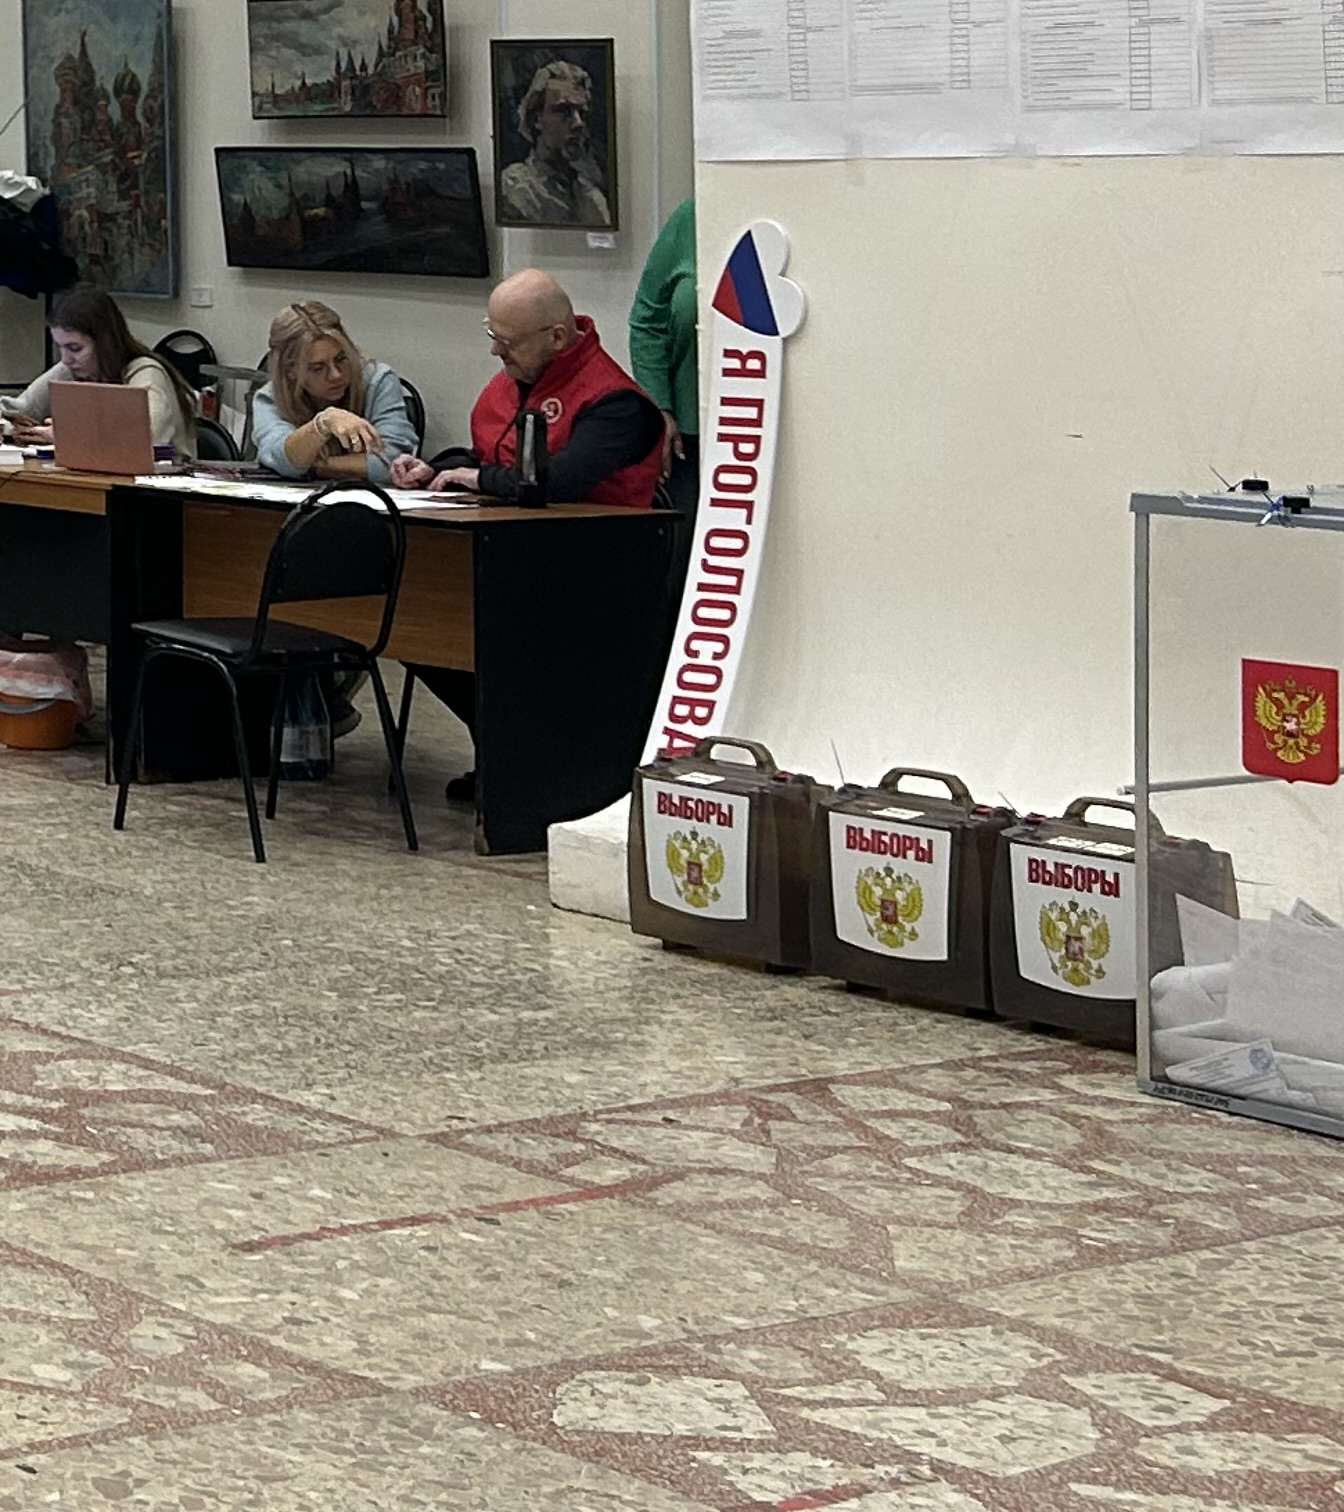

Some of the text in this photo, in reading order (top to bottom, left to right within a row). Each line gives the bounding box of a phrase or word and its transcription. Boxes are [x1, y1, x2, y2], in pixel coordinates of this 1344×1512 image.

[722, 348, 766, 379] Я
[657, 791, 733, 828] ВЫБОРЫ
[846, 825, 933, 864] ВЫБОРЫ
[1027, 857, 1120, 898] ВЫБОРЫ
